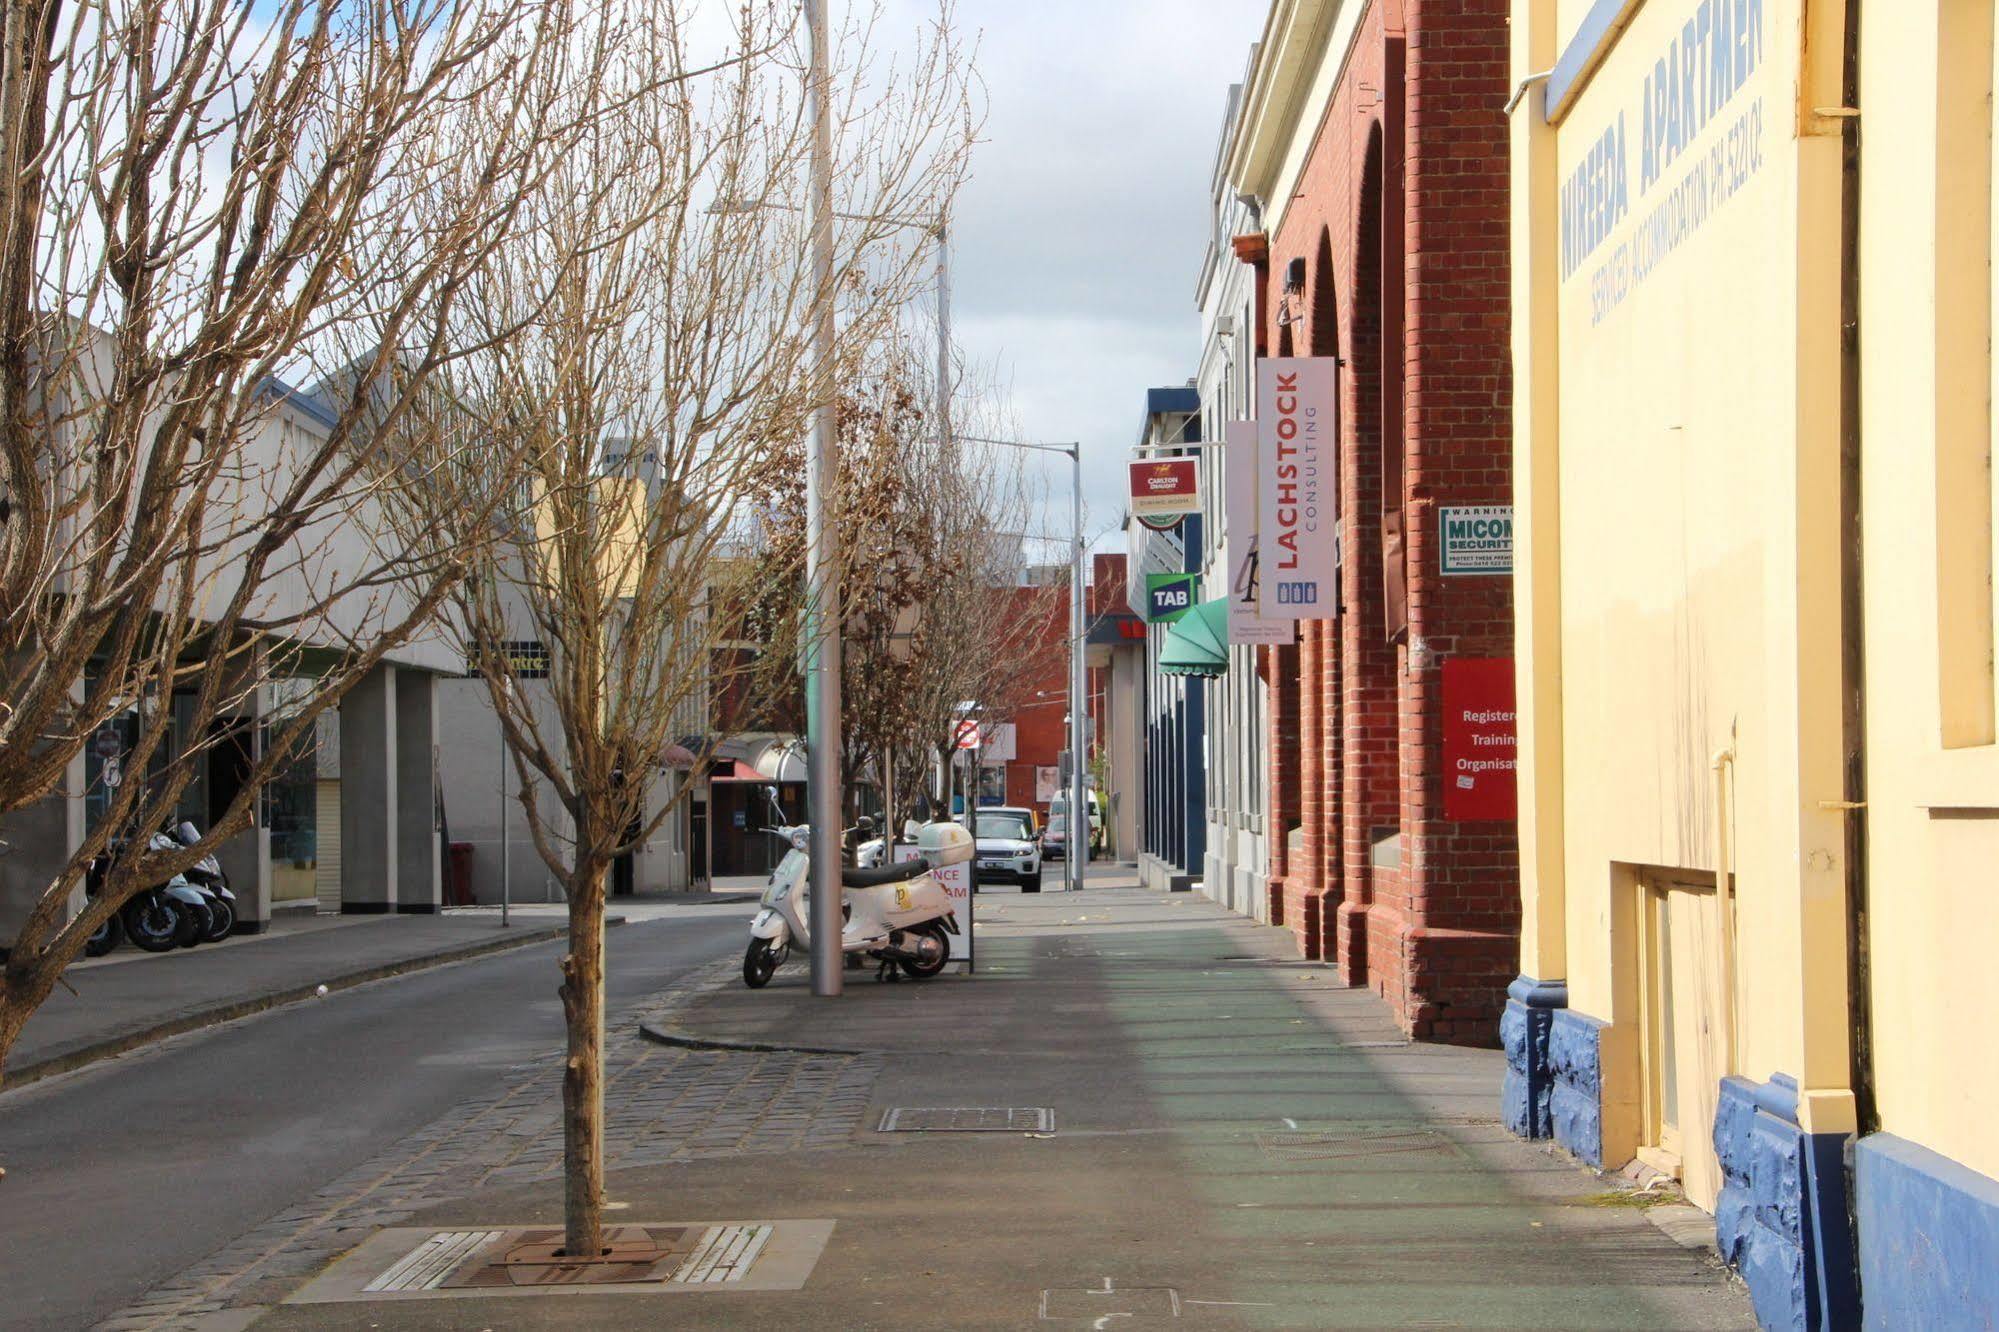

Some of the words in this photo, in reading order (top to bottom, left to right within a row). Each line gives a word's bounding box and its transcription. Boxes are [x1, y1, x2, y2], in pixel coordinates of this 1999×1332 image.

[1561, 107, 1628, 284] NIREEDA
[1591, 241, 1628, 328] SERVICED
[1276, 371, 1298, 570] LACHSTOCK
[1305, 406, 1317, 533] CONSULTING
[1147, 477, 1179, 485] CARLTON
[1448, 540, 1513, 550] SECURIT
[1154, 590, 1189, 606] TAB
[1463, 710, 1517, 724] Register
[1471, 733, 1518, 747] Trainin
